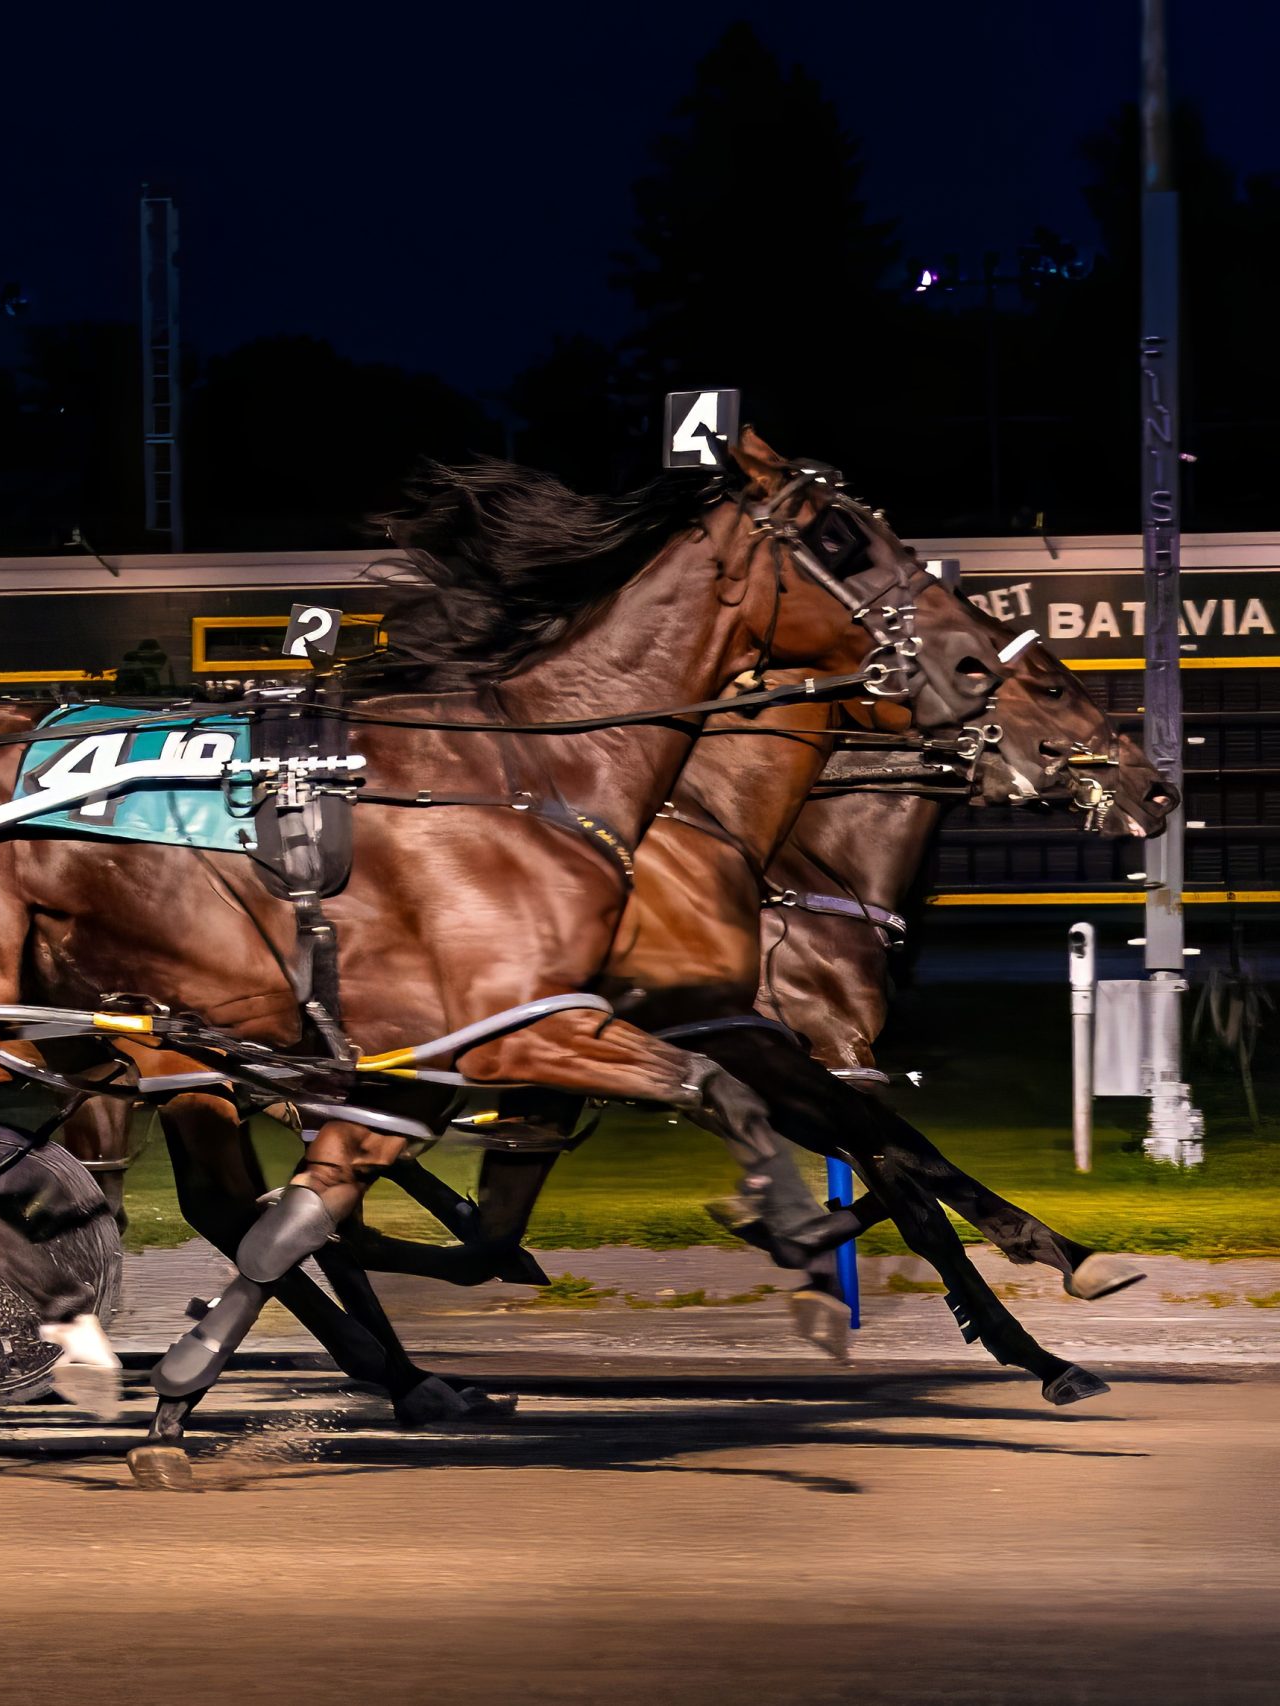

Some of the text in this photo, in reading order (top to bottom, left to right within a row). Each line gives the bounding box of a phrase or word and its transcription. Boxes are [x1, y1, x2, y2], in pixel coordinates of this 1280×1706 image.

[672, 392, 727, 465] 4
[968, 583, 1031, 621] BET
[1049, 598, 1277, 638] BATVIA
[290, 607, 333, 657] 2
[37, 732, 128, 816] 4
